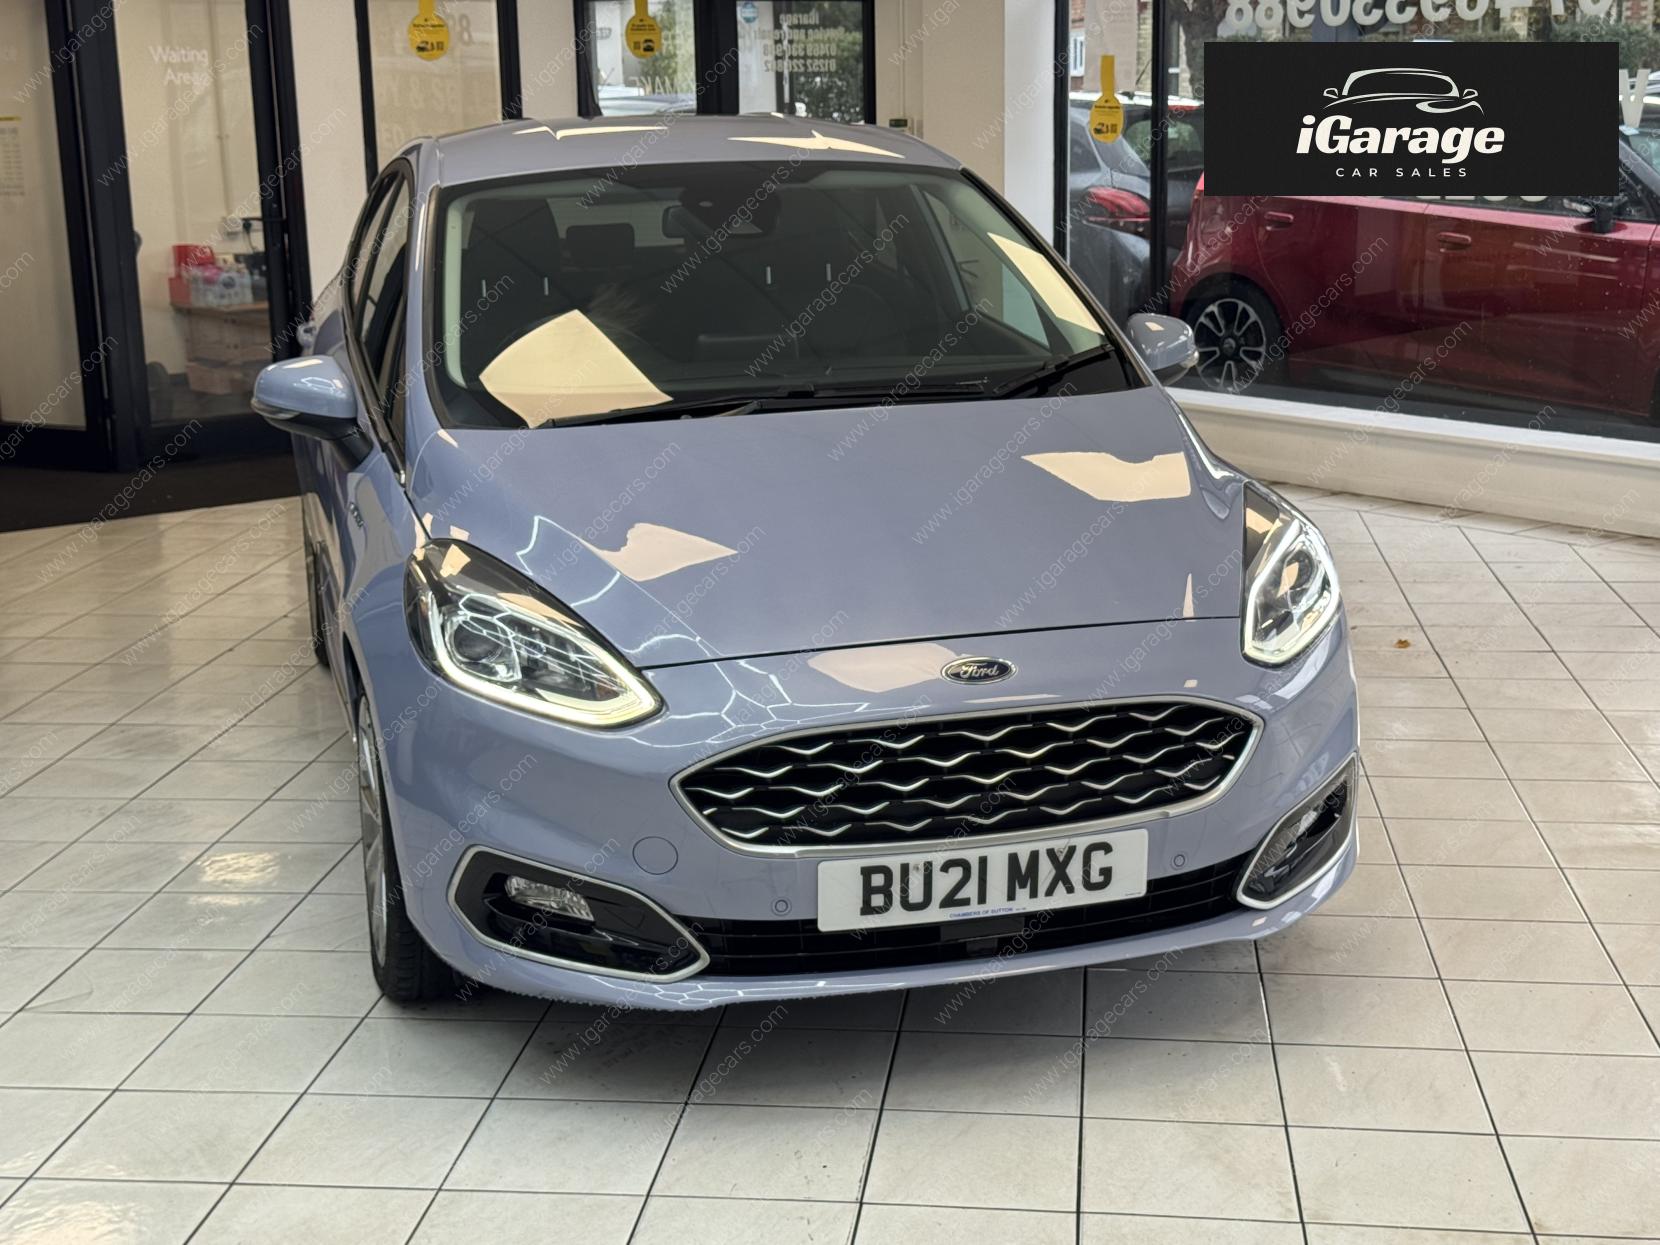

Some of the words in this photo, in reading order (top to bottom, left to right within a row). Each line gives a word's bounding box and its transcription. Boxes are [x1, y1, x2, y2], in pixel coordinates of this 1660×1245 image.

[148, 46, 209, 66] Waiting
[960, 663, 999, 679] Ford
[860, 855, 988, 916] BU21
[1006, 841, 1113, 902] MXG
